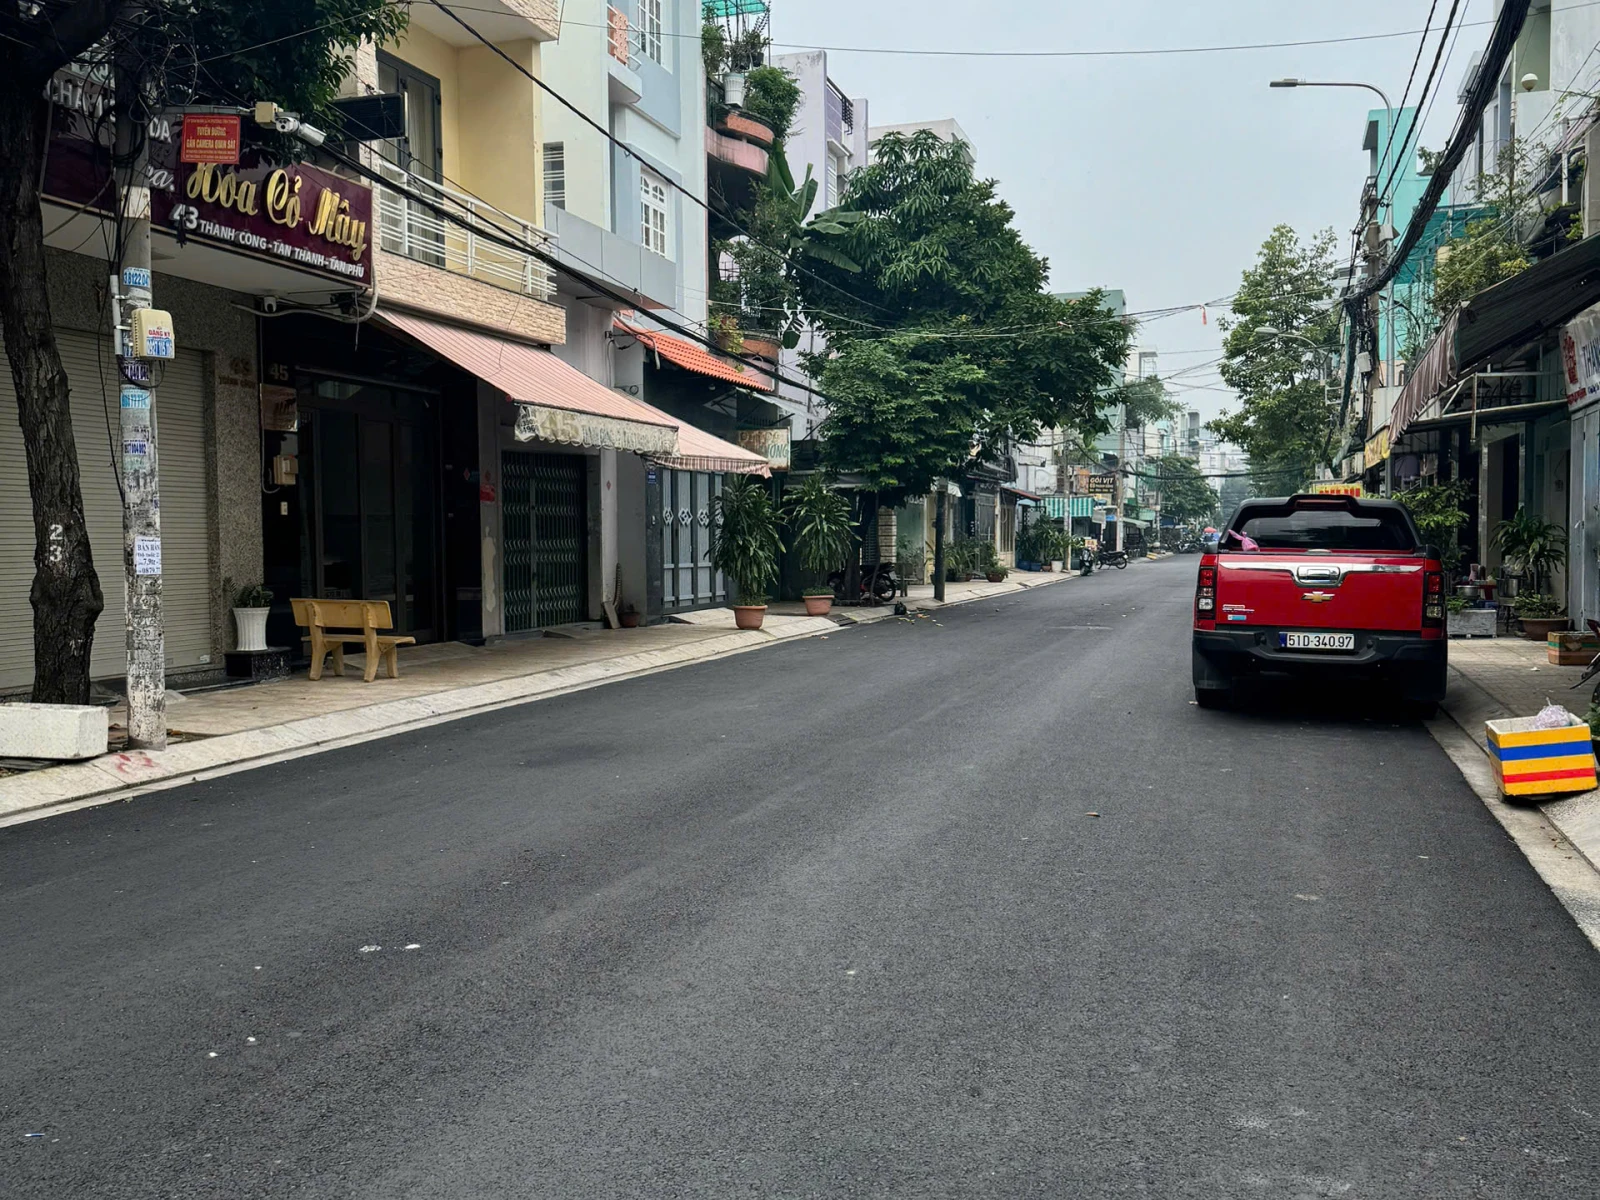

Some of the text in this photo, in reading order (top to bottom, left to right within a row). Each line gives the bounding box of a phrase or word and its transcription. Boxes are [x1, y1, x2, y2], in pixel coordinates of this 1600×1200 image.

[196, 139, 213, 148] CAMERA
[170, 203, 199, 230] 43
[266, 169, 303, 228] Cỏ
[308, 187, 366, 260] Mây
[269, 363, 289, 381] 45
[1288, 635, 1352, 648] 51D-340.97
